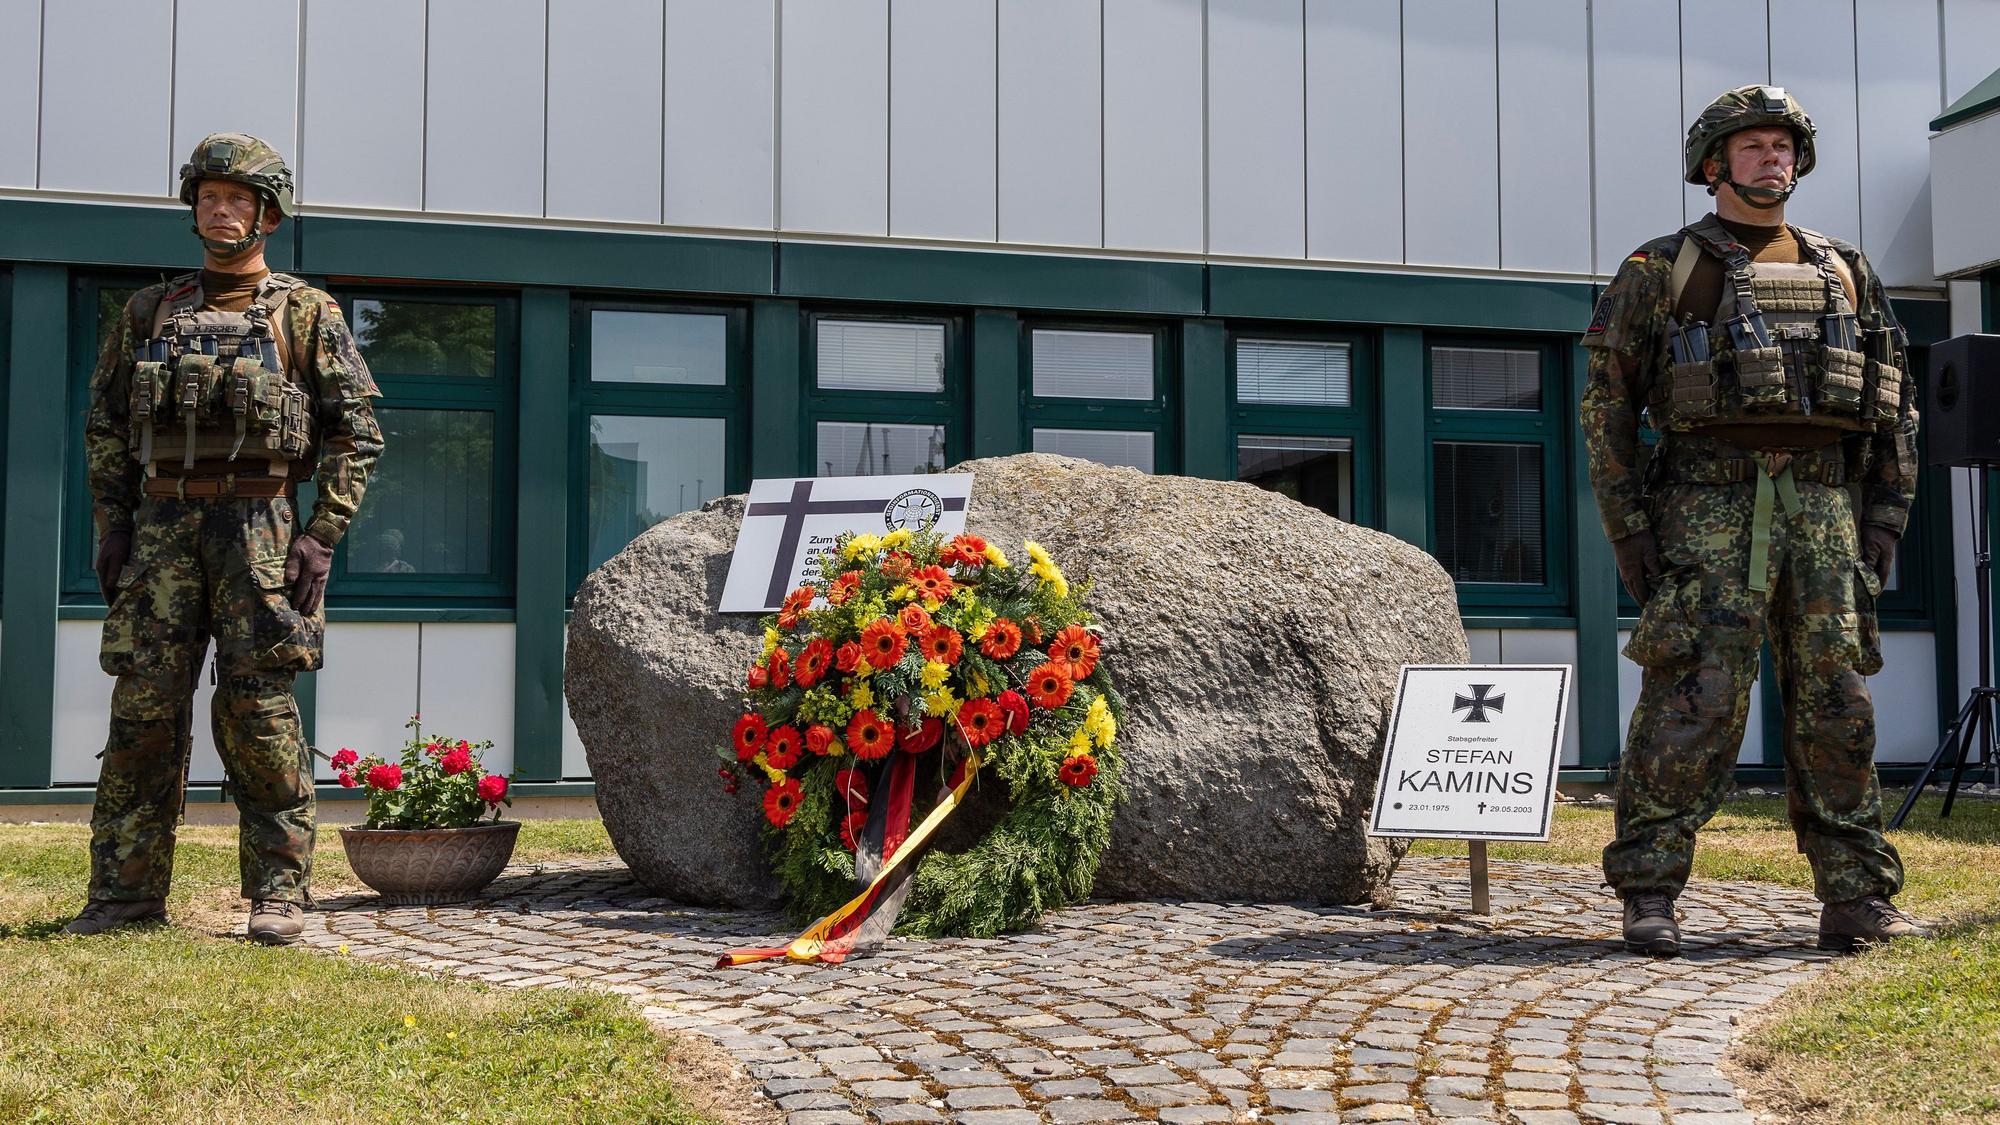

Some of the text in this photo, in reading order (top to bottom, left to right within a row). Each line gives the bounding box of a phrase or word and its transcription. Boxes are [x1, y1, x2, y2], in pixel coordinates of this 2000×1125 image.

[204, 325, 239, 333] FISCHER
[886, 489, 940, 516] GEOINFORMATIONSDIENST
[809, 536, 833, 544] Zum
[822, 546, 837, 555] di
[802, 568, 820, 576] der
[1447, 735, 1498, 743] Stabsgefreiter
[1426, 749, 1513, 765] STEFAN
[1398, 770, 1533, 795] KAMINS
[1408, 804, 1450, 812] 23.01.1975
[1489, 805, 1533, 814] 29.05.2003
